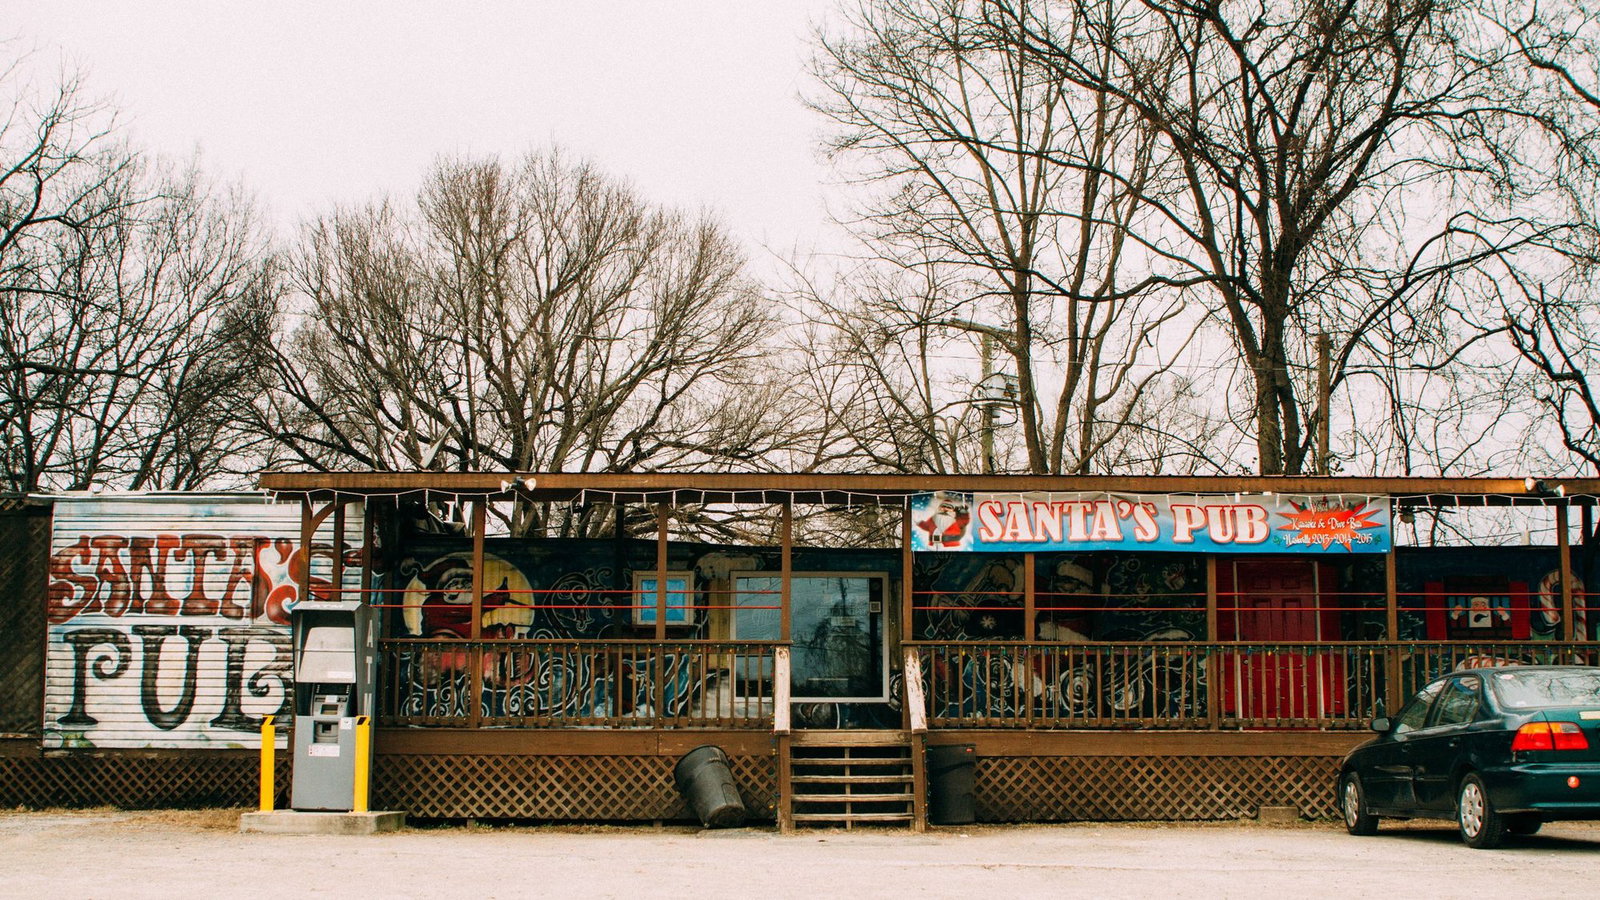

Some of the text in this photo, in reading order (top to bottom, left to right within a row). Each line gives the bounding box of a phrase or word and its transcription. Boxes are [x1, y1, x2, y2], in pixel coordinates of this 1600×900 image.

[978, 500, 1270, 543] SANTA'S PUB
[1318, 518, 1326, 529] &
